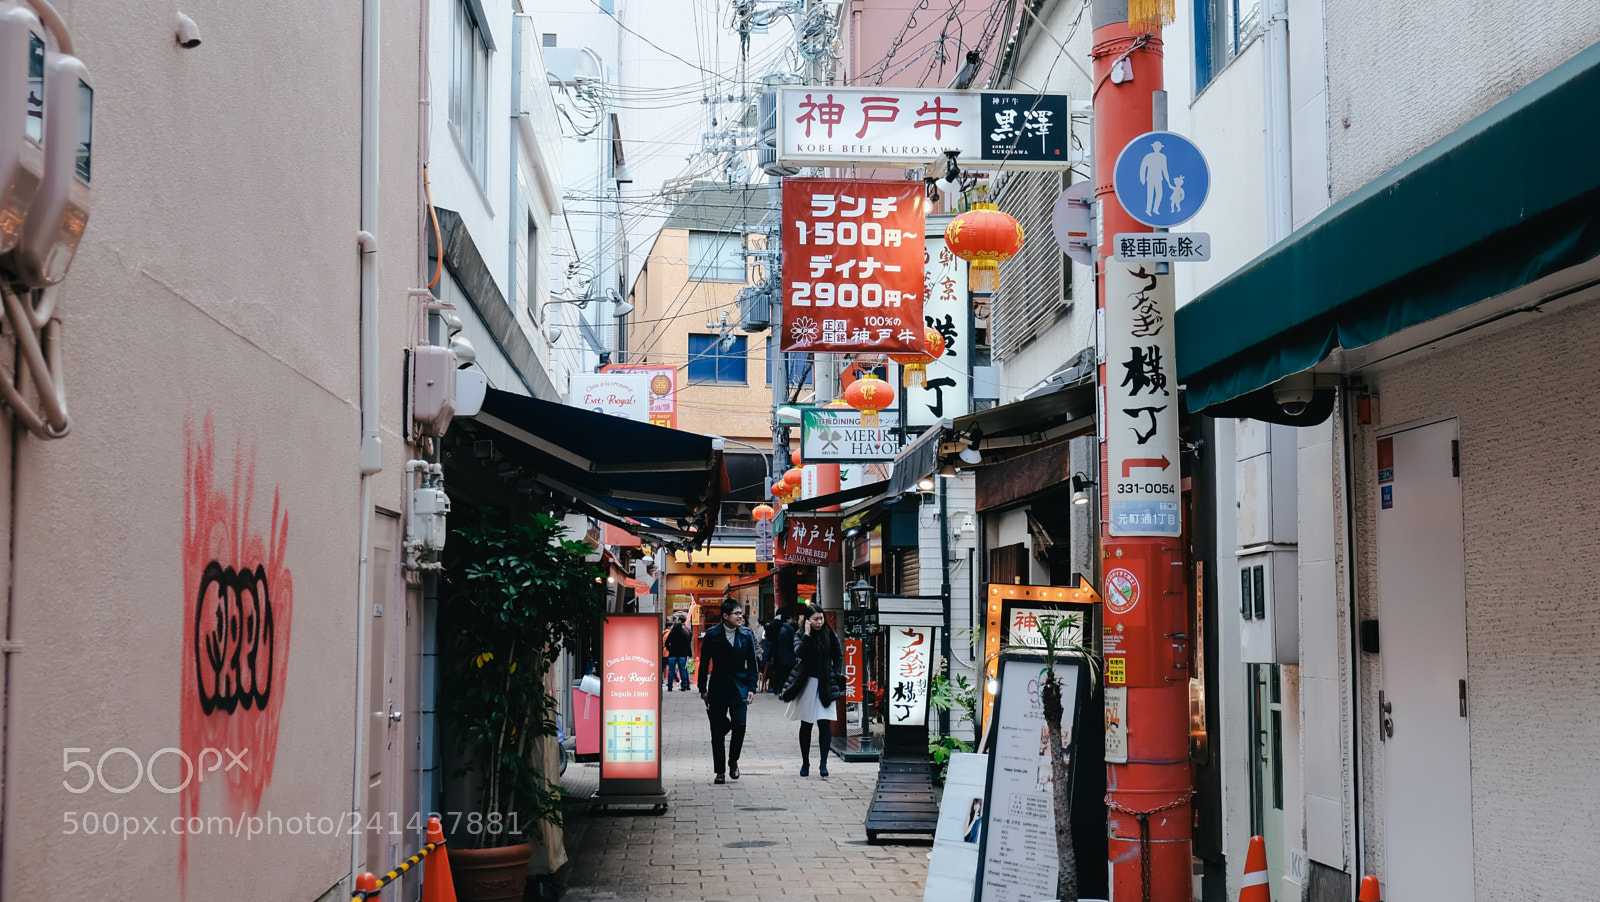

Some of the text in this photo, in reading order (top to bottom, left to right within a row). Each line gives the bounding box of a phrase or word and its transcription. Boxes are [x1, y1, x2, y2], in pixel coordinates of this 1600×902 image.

[992, 97, 1019, 105] 神戸牛
[796, 93, 963, 141] 神戸牛
[990, 109, 1053, 154] 黒澤
[797, 143, 833, 153] KOBE
[842, 144, 873, 154] BEEF
[810, 193, 897, 219] ランチ
[1120, 237, 1203, 258] 軽車両を除く
[809, 254, 901, 279] ディナー
[864, 316, 901, 327] 100%の
[851, 329, 917, 346] 神戸牛
[607, 394, 636, 407] Royal
[1117, 482, 1175, 495] 331-0054
[1118, 513, 1175, 525] 元町通1丁目
[792, 521, 836, 550] 神戸牛
[784, 553, 806, 563] TAJIMA
[796, 546, 828, 559] KOBE BEEF
[845, 643, 857, 698] ウーロン茶
[628, 672, 656, 685] Royal
